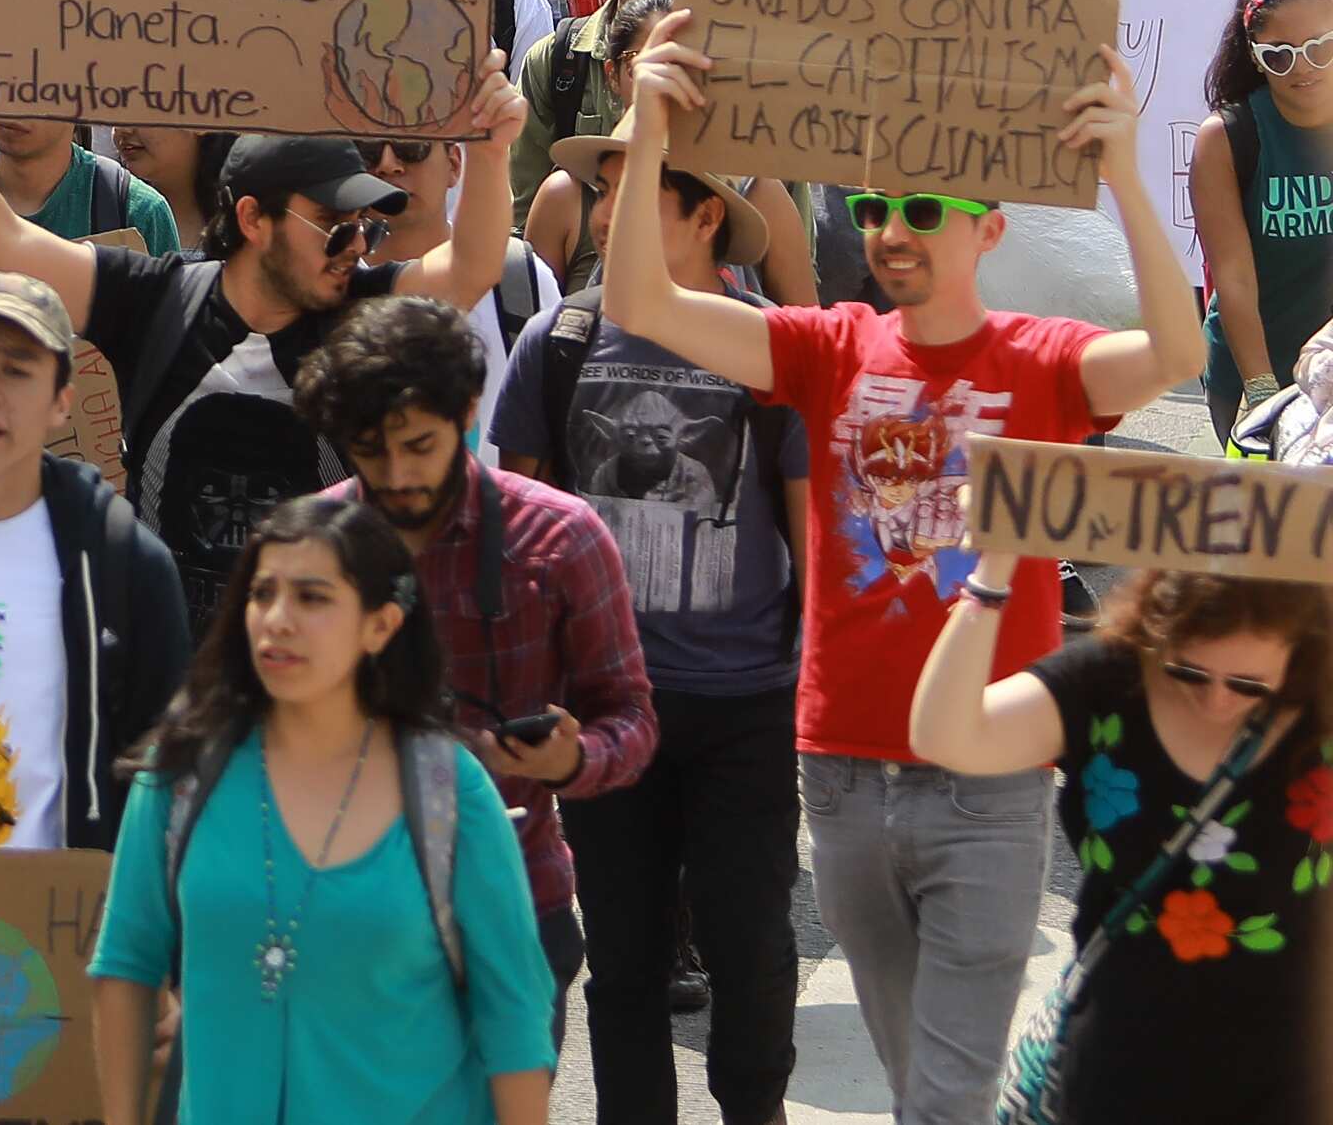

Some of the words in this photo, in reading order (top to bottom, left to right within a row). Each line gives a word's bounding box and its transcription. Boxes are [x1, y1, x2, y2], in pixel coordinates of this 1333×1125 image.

[702, 19, 789, 89] EL
[694, 100, 717, 145] Y
[731, 101, 776, 146] LA
[789, 103, 892, 163] CRISIS
[1263, 174, 1333, 212] UND
[1262, 212, 1333, 238] ARM
[606, 365, 662, 382] WORDS
[664, 368, 686, 383] OF
[689, 370, 743, 389] WISD
[979, 452, 1088, 539] NO
[1109, 464, 1296, 561] TREN
